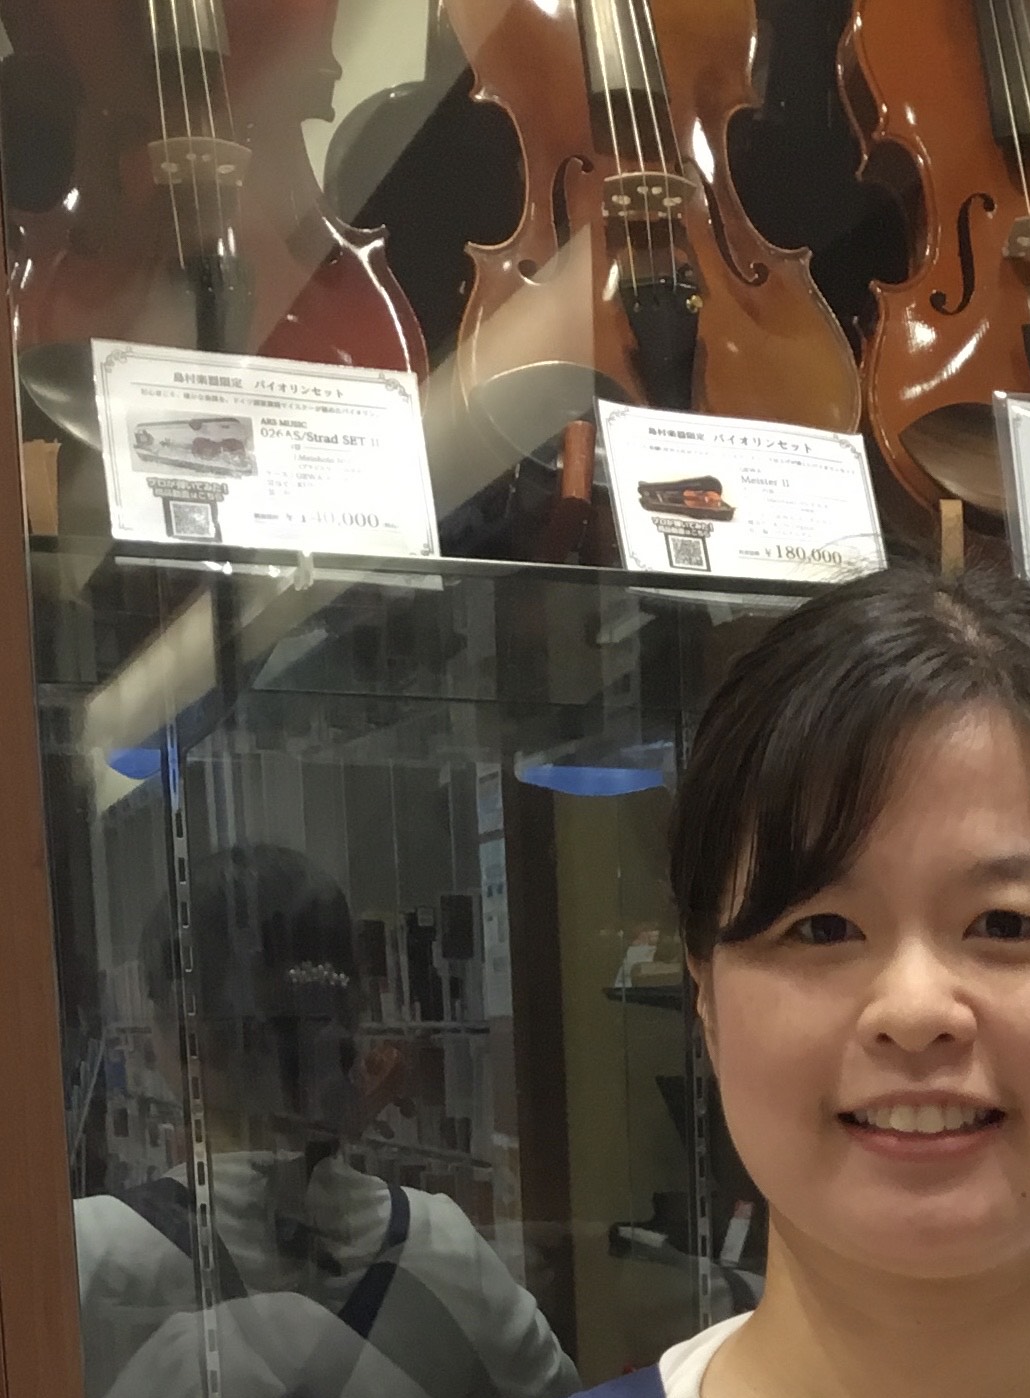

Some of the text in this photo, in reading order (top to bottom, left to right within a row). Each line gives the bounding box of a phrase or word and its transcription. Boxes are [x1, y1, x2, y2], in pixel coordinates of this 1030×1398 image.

[254, 380, 344, 399] バイオリンセット
[342, 435, 366, 446] SET
[713, 433, 812, 454] バイオリンセット
